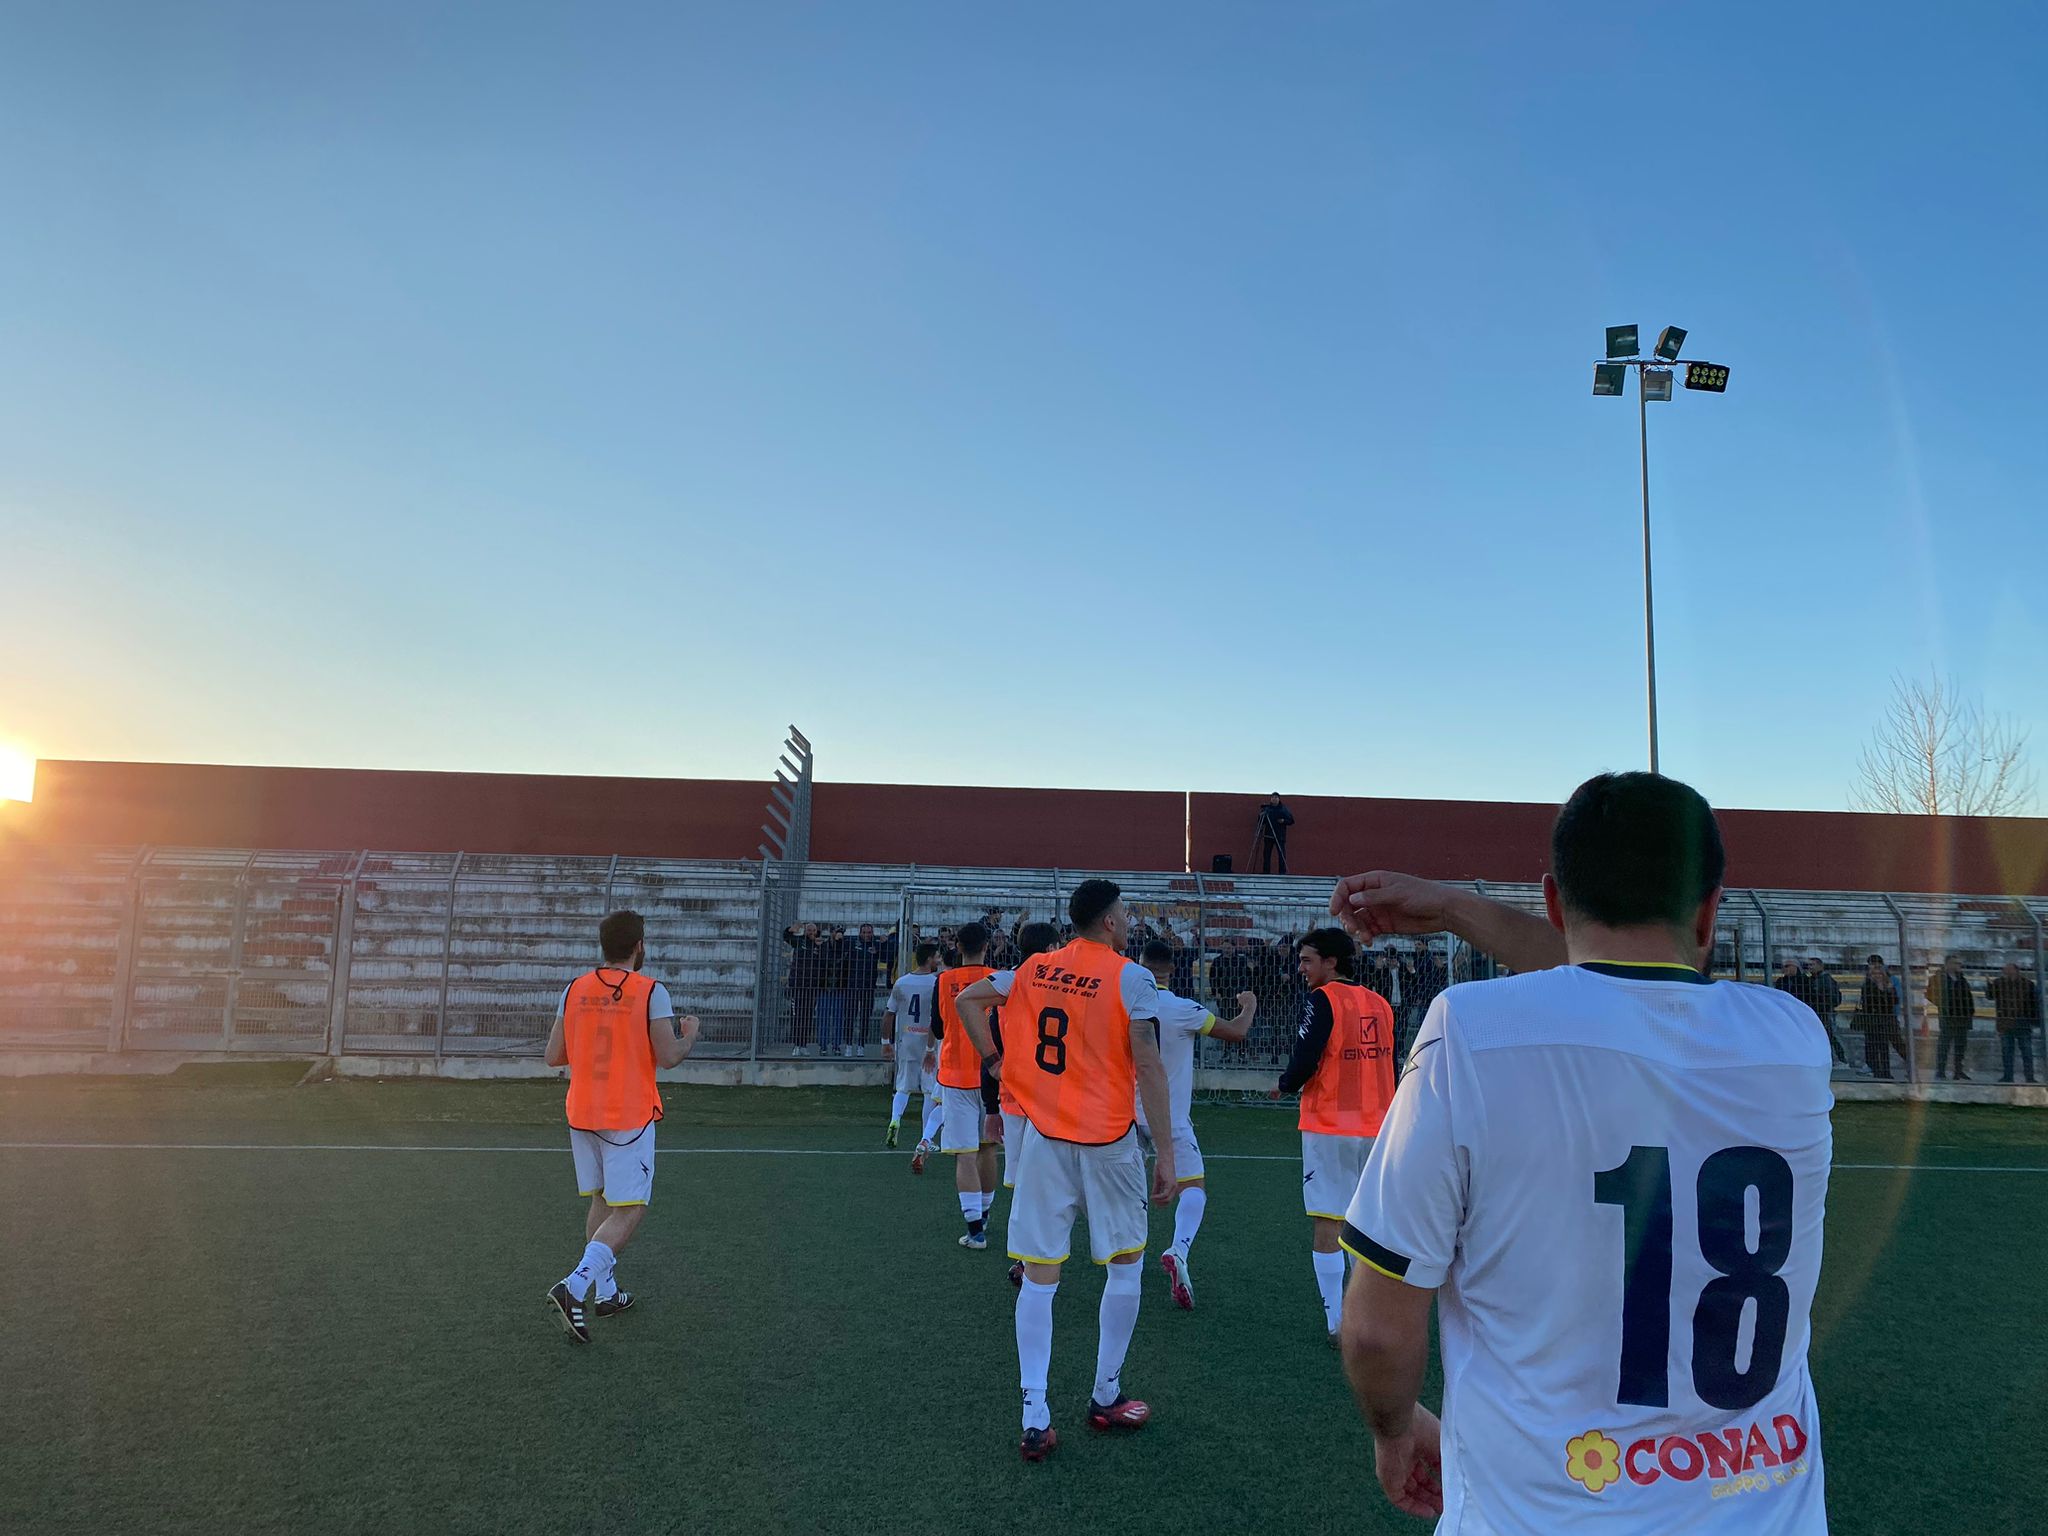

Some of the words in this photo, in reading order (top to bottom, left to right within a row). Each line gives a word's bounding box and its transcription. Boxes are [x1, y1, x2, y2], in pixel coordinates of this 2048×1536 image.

[908, 993, 920, 1023] 4
[1047, 967, 1102, 990] Zeus
[1035, 1006, 1069, 1075] 8
[1594, 1145, 1793, 1410] 18
[1625, 1414, 1808, 1485] CONAD
